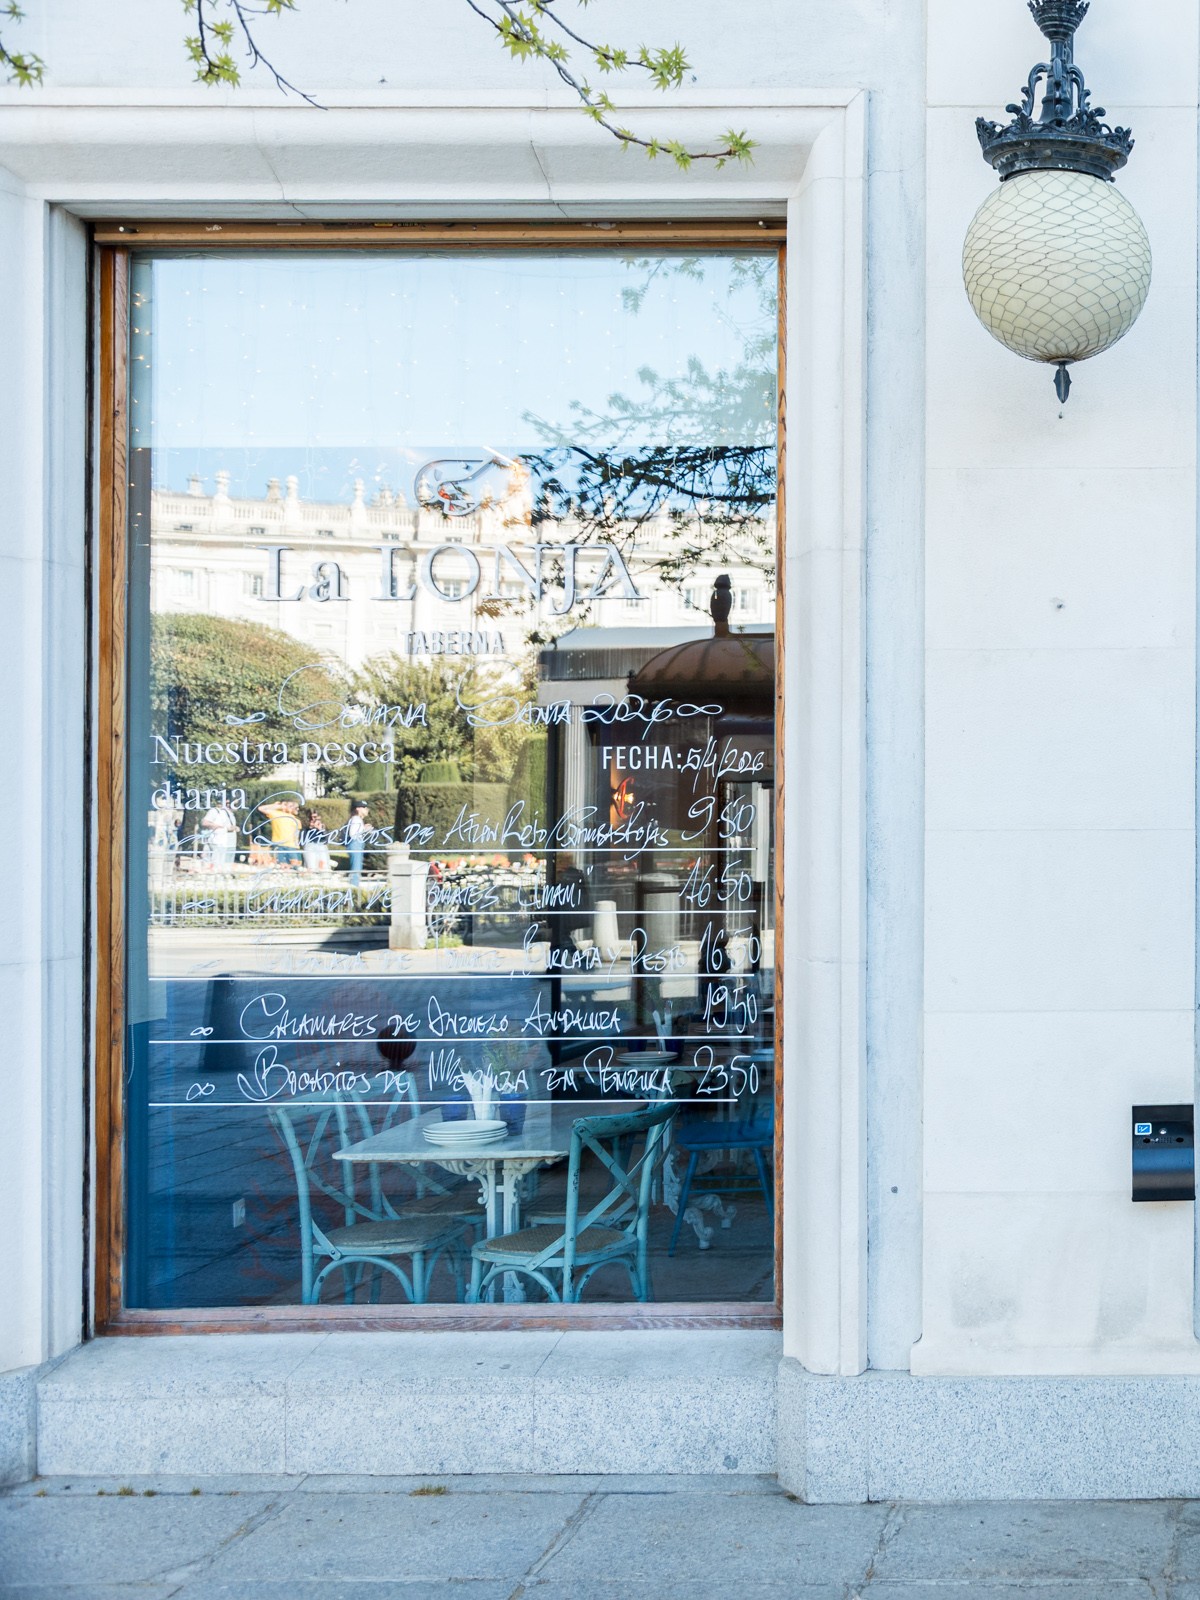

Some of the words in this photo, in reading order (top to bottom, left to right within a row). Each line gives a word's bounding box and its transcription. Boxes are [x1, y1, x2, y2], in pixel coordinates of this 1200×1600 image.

[256, 545, 350, 602] La
[370, 544, 650, 616] LONJA
[400, 630, 505, 656] TABERNA
[150, 735, 289, 764] Nuestra
[299, 740, 398, 773] pesca
[602, 746, 682, 770] FECHA:
[151, 781, 249, 811] diaria
